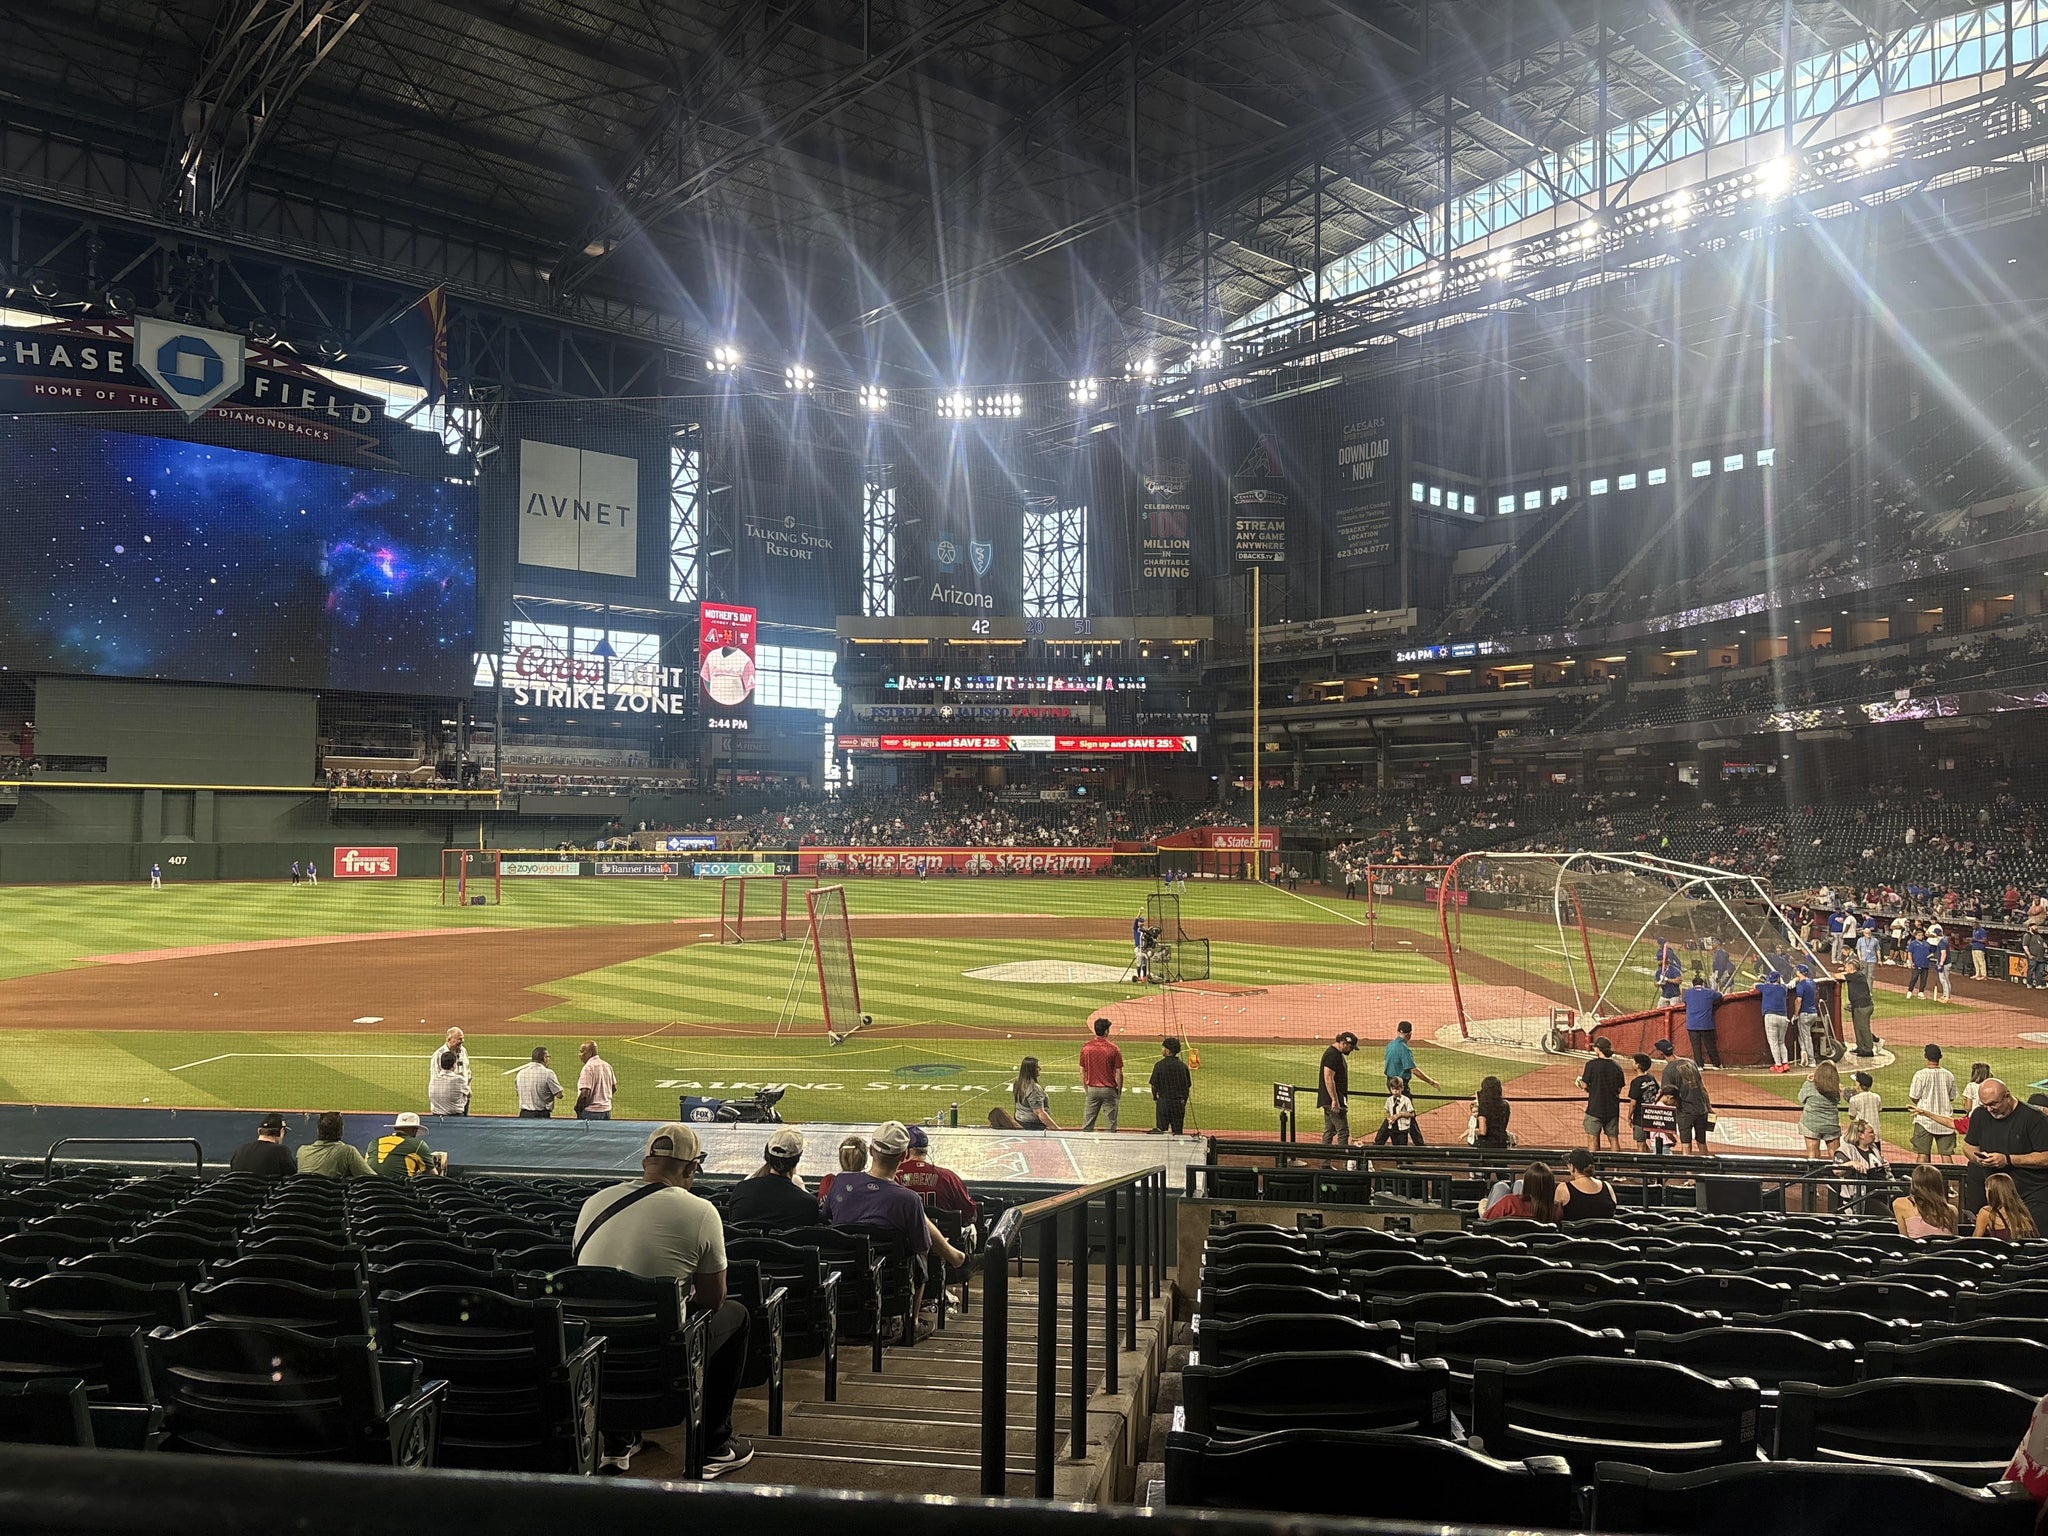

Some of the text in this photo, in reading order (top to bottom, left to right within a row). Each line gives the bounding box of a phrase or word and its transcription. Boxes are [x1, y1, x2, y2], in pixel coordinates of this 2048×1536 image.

[255, 377, 372, 424] FIELD
[35, 384, 329, 440] HOME OF THE DIAMONDBACKS
[1343, 417, 1385, 435] CAESARS
[1338, 438, 1389, 466] DOWNLOAD
[1352, 460, 1375, 482] NOW
[526, 493, 631, 528] AVNET
[1236, 520, 1285, 531] STREAM
[744, 523, 833, 549] TALKING STICK
[1347, 530, 1379, 541] LOCATION
[766, 541, 813, 560] RESORT
[1143, 539, 1190, 549] MILLION
[1143, 567, 1190, 578] GIVING
[930, 583, 993, 609] Arizona
[704, 609, 753, 623] MOTHER'S DAY
[971, 619, 990, 634] 42
[1026, 619, 1046, 635] 20
[1074, 620, 1092, 635] 51
[1396, 649, 1433, 662] 2:44 PM
[514, 645, 684, 688] Coors LIGHT
[514, 684, 684, 714] STRIKE ZONE
[871, 707, 937, 717] ESTRELLA
[955, 707, 1010, 717] JALISCO
[708, 719, 748, 729] 2:44 PM
[903, 738, 922, 748] Sign
[923, 740, 934, 748] up
[935, 738, 952, 747] and
[953, 738, 981, 748] SAVE
[1079, 739, 1098, 749] Sign
[1098, 740, 1110, 749] up
[1110, 739, 1127, 748] and
[1127, 739, 1155, 748] SAVE
[1227, 836, 1271, 848] State Frm
[168, 856, 187, 865] 407
[341, 850, 391, 874] fry's
[848, 853, 896, 870] State
[996, 854, 1091, 871] State Farm
[612, 864, 642, 873] Banner
[738, 864, 765, 874] COX
[776, 864, 790, 873] 374
[862, 1082, 989, 1092] STICK
[1644, 1109, 1673, 1117] ADVANTAGE
